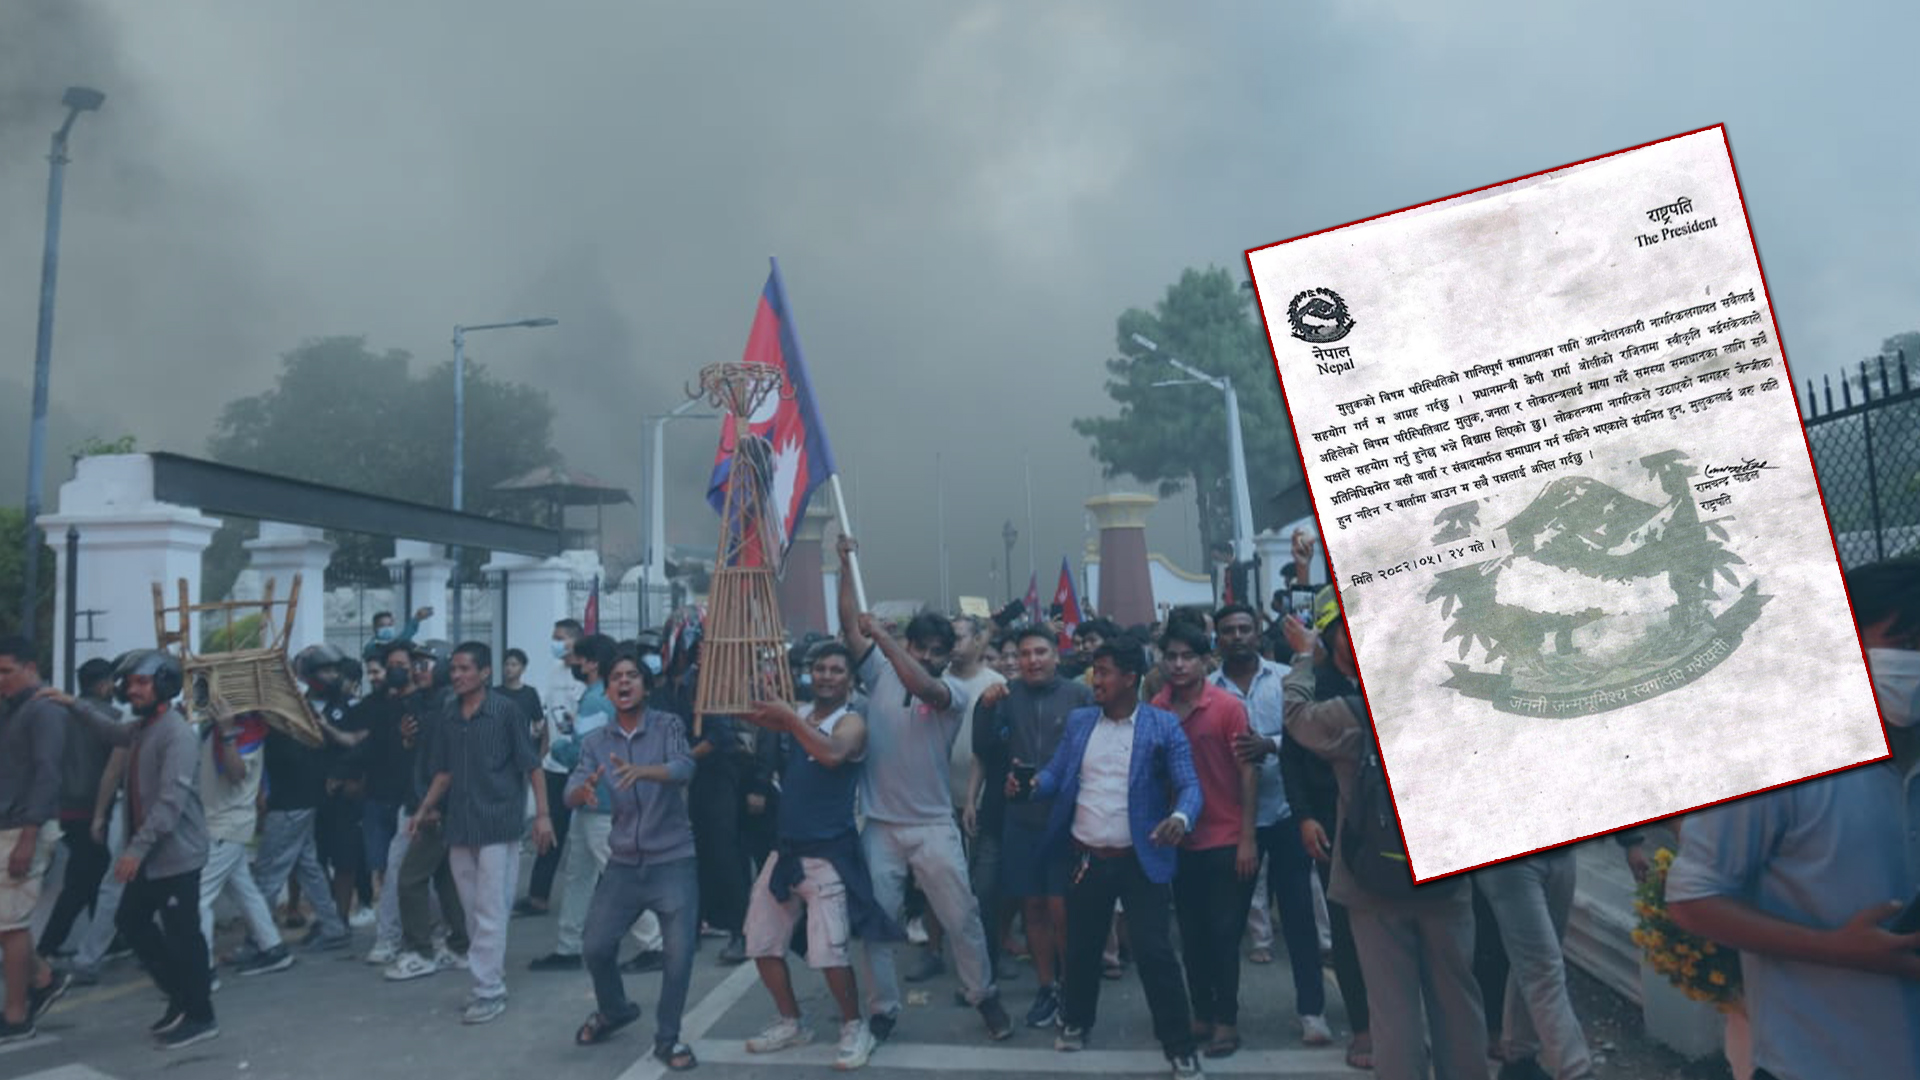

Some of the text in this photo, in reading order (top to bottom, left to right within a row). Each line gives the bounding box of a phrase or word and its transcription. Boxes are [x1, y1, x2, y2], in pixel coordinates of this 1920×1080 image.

[1634, 217, 1718, 248] The President
[1646, 196, 1693, 225] राष्ट्रपति
[1312, 344, 1351, 361] नेपाल
[1316, 358, 1355, 376] Nepal
[1335, 393, 1375, 416] मुलुकको
[1407, 370, 1459, 395] परिस्थितिको
[1462, 358, 1503, 379] शान्तिपूर्ण
[1505, 346, 1554, 368] समाधानका
[1556, 338, 1579, 353] लागि
[1584, 319, 1645, 345] आन्दोलनकारी
[1310, 424, 1346, 442] सहयोग
[1352, 416, 1369, 430] गर्न
[1374, 415, 1385, 424] म
[1392, 407, 1418, 420] आग्रह
[1424, 397, 1449, 412] गर्दछु
[1471, 377, 1518, 400] प्रधानमन्त्री
[1523, 370, 1544, 384] केपी
[1550, 361, 1570, 378] शर्मा
[1577, 351, 1613, 370] ओलीको
[1618, 341, 1659, 359] राजिनामा
[1319, 442, 1359, 462] अहिलेको
[1484, 404, 1510, 417] जनता
[1513, 401, 1523, 411] र
[1525, 381, 1583, 407] लोकतन्त्रलाई
[1587, 377, 1609, 390] माया
[1613, 368, 1628, 383] गर्दै
[1633, 362, 1665, 378] समस्या
[1668, 347, 1717, 367] समाधानका
[1722, 337, 1745, 352] लागि
[1323, 467, 1350, 483] पक्षले
[1354, 457, 1389, 475] सहयोग
[1392, 450, 1410, 467] गर्नु
[1412, 446, 1437, 464] हुनेछ
[1440, 438, 1457, 452] भन्ने
[1494, 420, 1526, 438] लिएको
[1552, 402, 1603, 422] लोकतन्त्रमा
[1607, 387, 1650, 407] नागरिकले
[1654, 375, 1692, 396] उठाएको
[1329, 480, 1390, 505] प्रतिनिधिसमेत
[1415, 465, 1437, 480] वार्ता
[1439, 466, 1449, 475] र
[1450, 450, 1502, 473] संवादमार्फत
[1504, 440, 1541, 458] समाधान
[1543, 433, 1559, 447] गर्न
[1562, 425, 1589, 443] सकिने
[1592, 415, 1628, 434] भएकाले
[1630, 408, 1664, 425] संयमित
[1687, 387, 1733, 413] मुलुकलाई
[1335, 513, 1352, 529] हुन
[1354, 505, 1380, 519] नदिन
[1383, 502, 1393, 511] र
[1394, 492, 1426, 508] वार्तामा
[1430, 485, 1457, 499] आउन
[1459, 482, 1469, 491] म
[1491, 464, 1526, 484] पक्षलाई
[1530, 459, 1556, 473] अपिल
[1558, 451, 1583, 466] गर्दछु
[1351, 571, 1373, 586] मिति
[1448, 547, 1463, 559] २४
[1467, 539, 1484, 552] गते
[1509, 694, 1548, 714] जननी
